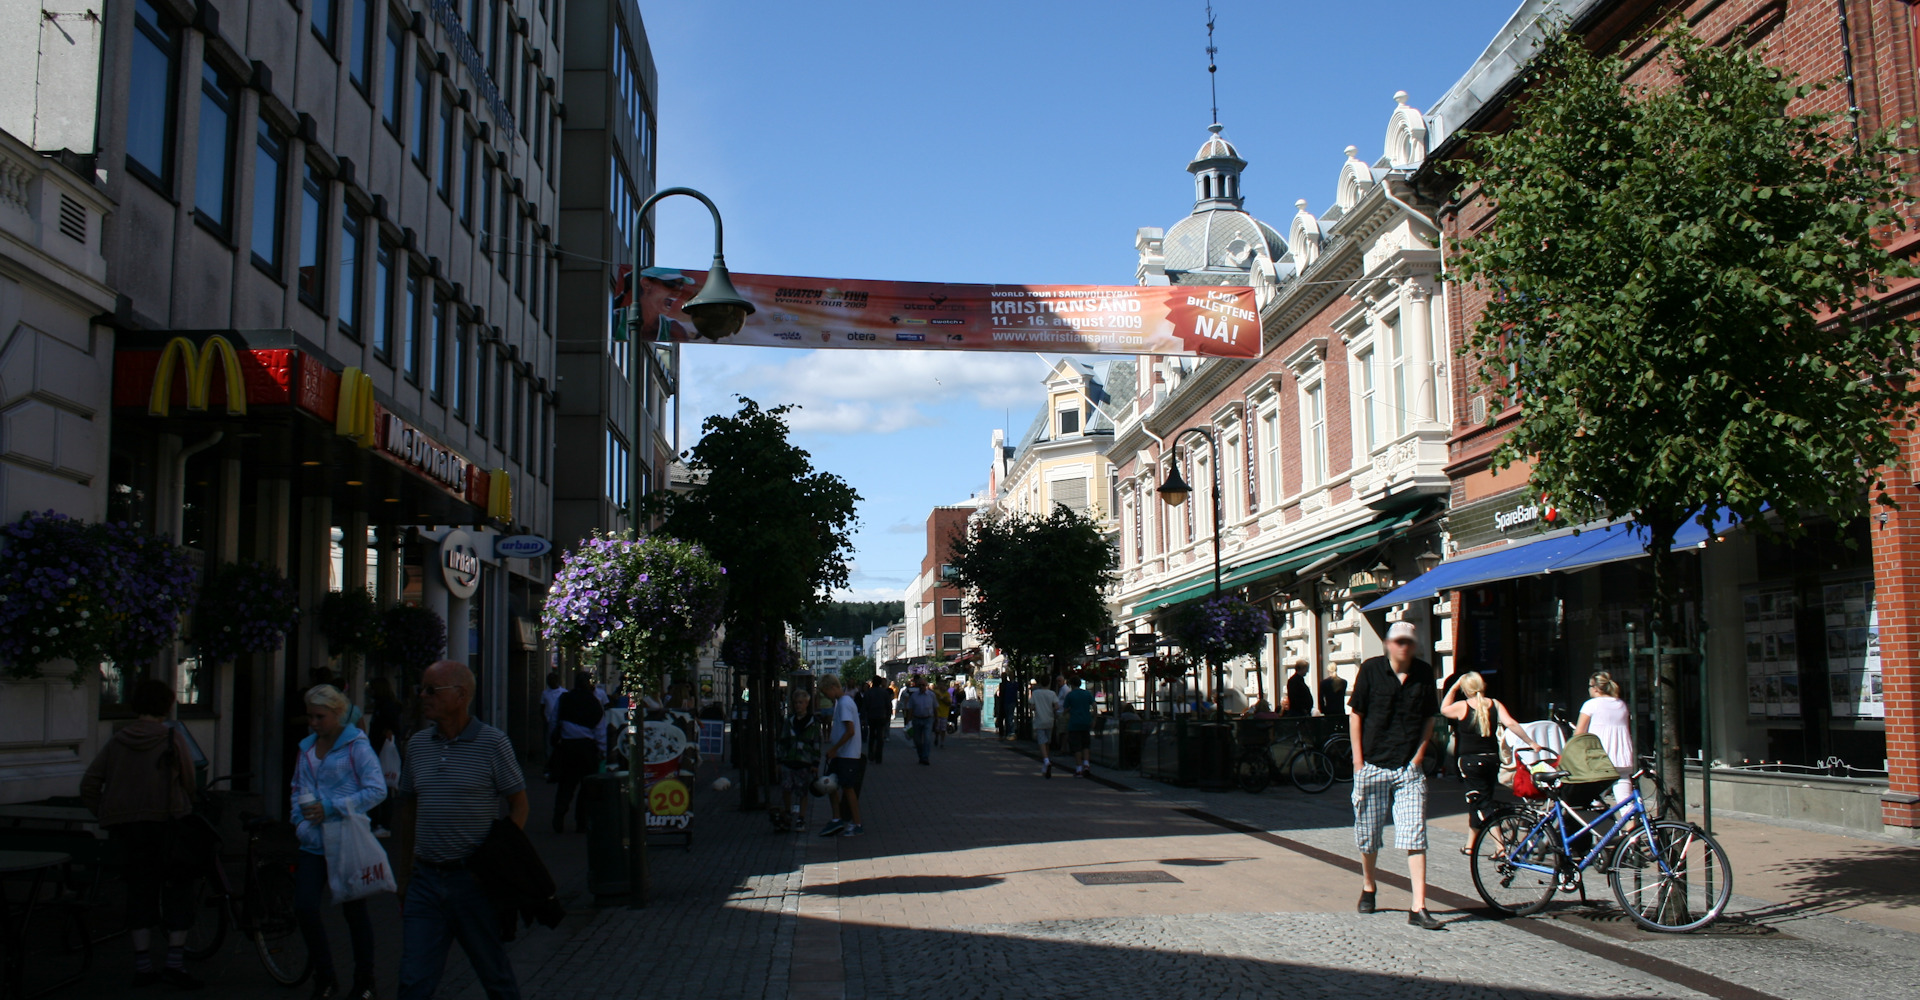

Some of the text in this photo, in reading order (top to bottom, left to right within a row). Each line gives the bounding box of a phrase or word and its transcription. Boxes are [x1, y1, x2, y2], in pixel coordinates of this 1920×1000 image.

[775, 288, 822, 298] SWATCH
[1059, 291, 1140, 299] SANDVOLLEYBALL
[1208, 290, 1239, 304] KJØP
[816, 300, 842, 308] TOUR
[844, 301, 867, 309] 2009
[992, 299, 1141, 313] KRISTIANSAND
[1187, 296, 1255, 322] BILLETTENE
[992, 317, 1013, 326] 11.
[1028, 316, 1048, 326] 16.
[1053, 317, 1104, 329] august
[1107, 316, 1142, 328] 2009
[847, 331, 877, 341] otera
[1194, 315, 1239, 345] NÅ!
[993, 332, 1143, 344] www.wtkristiansand.com
[1247, 396, 1255, 494] SHOPPING
[1495, 504, 1539, 532] SpareBank
[502, 540, 539, 550] urban
[449, 550, 477, 575] urban
[654, 790, 685, 811] 20
[645, 811, 694, 829] lurry
